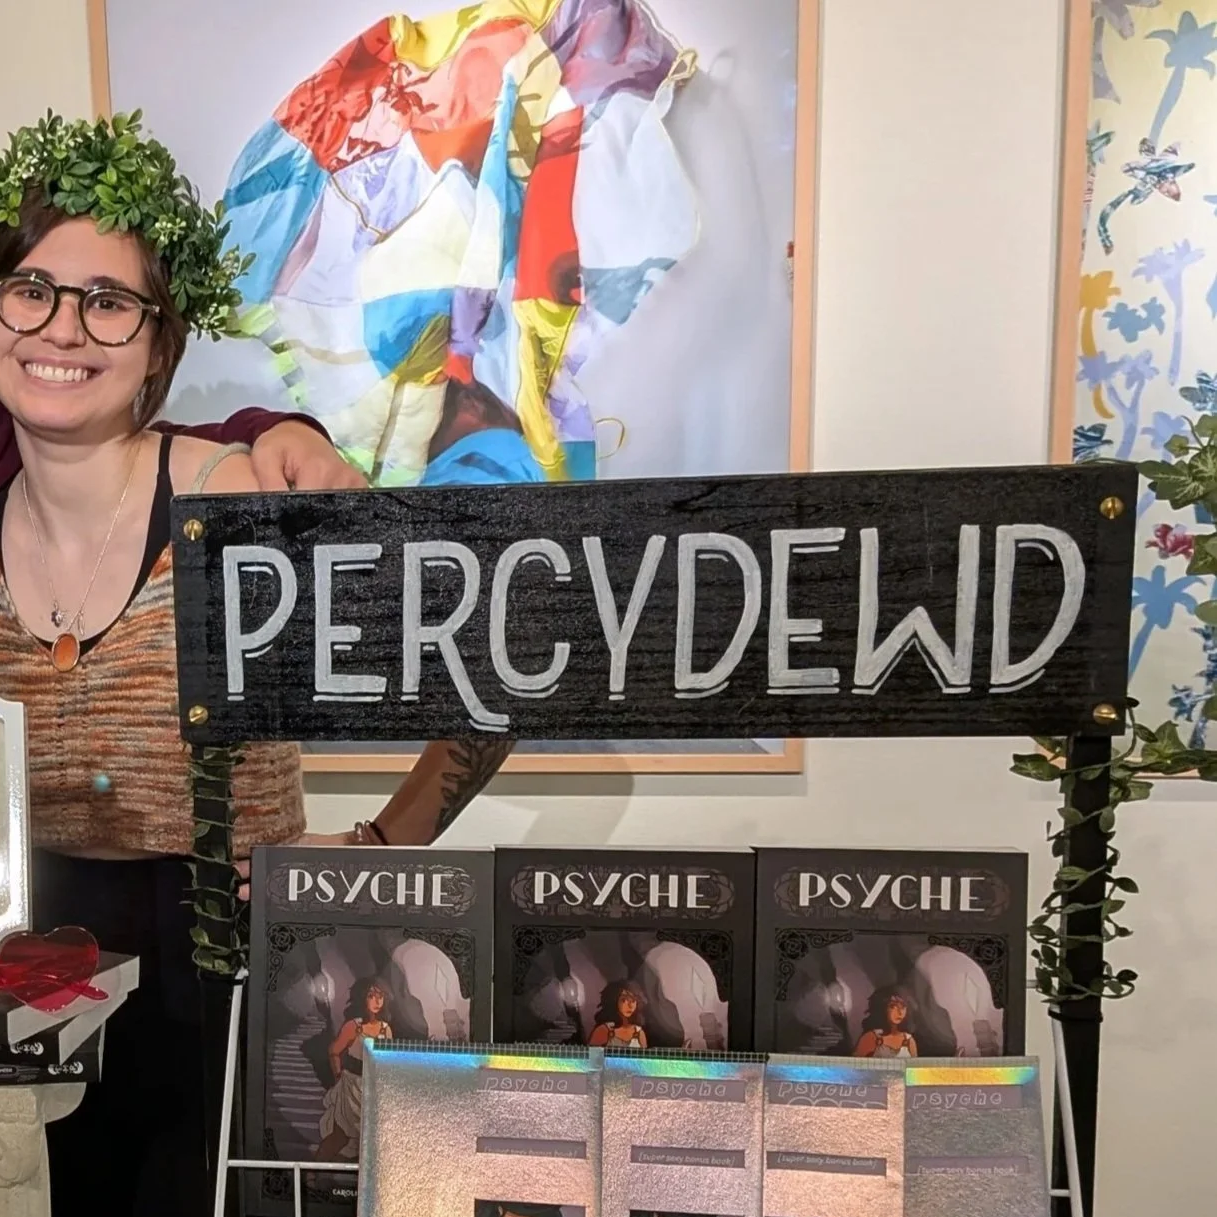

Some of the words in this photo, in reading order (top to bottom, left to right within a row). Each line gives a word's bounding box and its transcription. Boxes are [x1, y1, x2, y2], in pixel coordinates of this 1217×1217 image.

[222, 522, 1085, 734] PERCYDEWD
[288, 869, 454, 907] PSYCHE
[534, 871, 711, 908] PSYCHE
[799, 872, 985, 912] PSYCHE
[486, 1075, 568, 1092] psyche
[640, 1080, 727, 1097] psyche
[913, 1090, 1002, 1109] psyche
